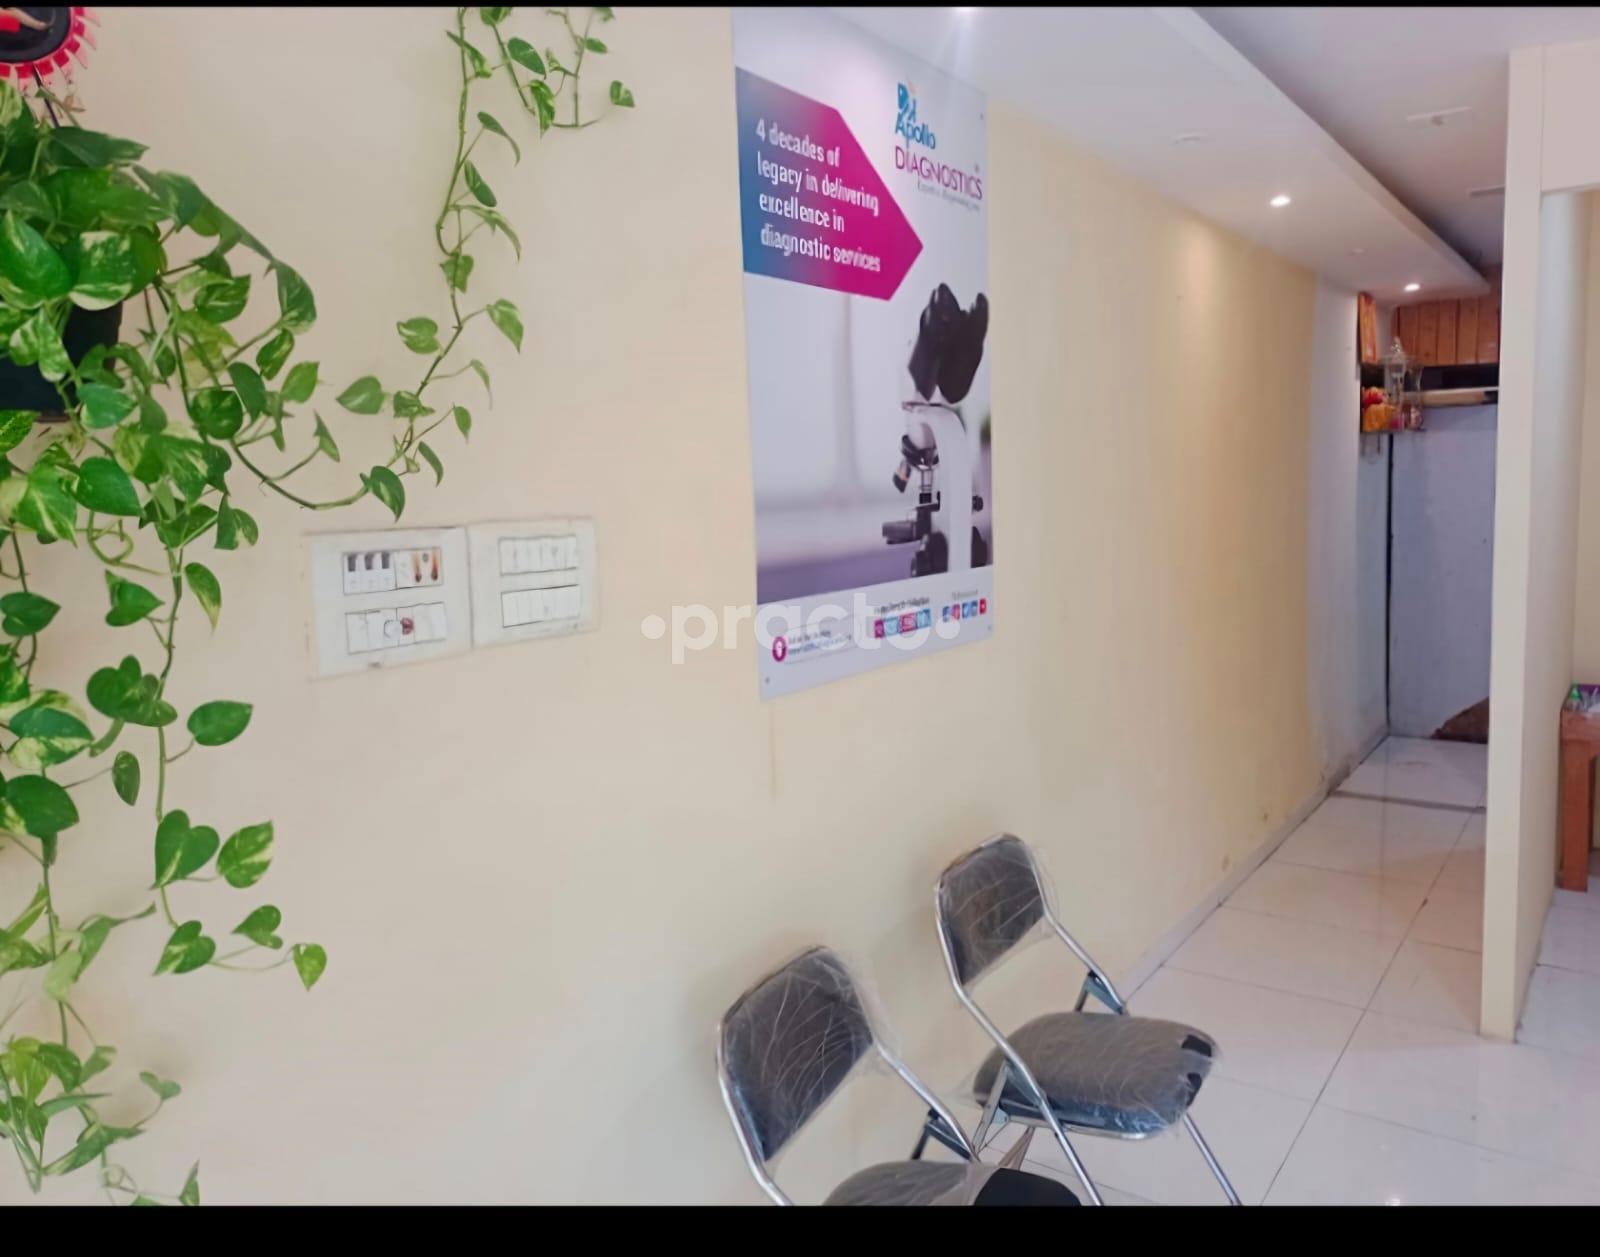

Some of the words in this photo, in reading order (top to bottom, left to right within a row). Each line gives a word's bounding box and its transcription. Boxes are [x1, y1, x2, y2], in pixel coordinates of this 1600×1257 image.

[755, 117, 765, 143] 4
[768, 122, 825, 162] decades
[826, 145, 841, 168] of
[894, 112, 936, 150] Apollo
[757, 151, 803, 193] legacy
[804, 167, 819, 194] in
[821, 174, 880, 217] delivering
[895, 145, 983, 201] DIAGNOSTICS
[759, 192, 830, 228] excellence
[832, 208, 845, 233] in
[760, 222, 831, 262] diagnostic
[832, 245, 881, 273] services
